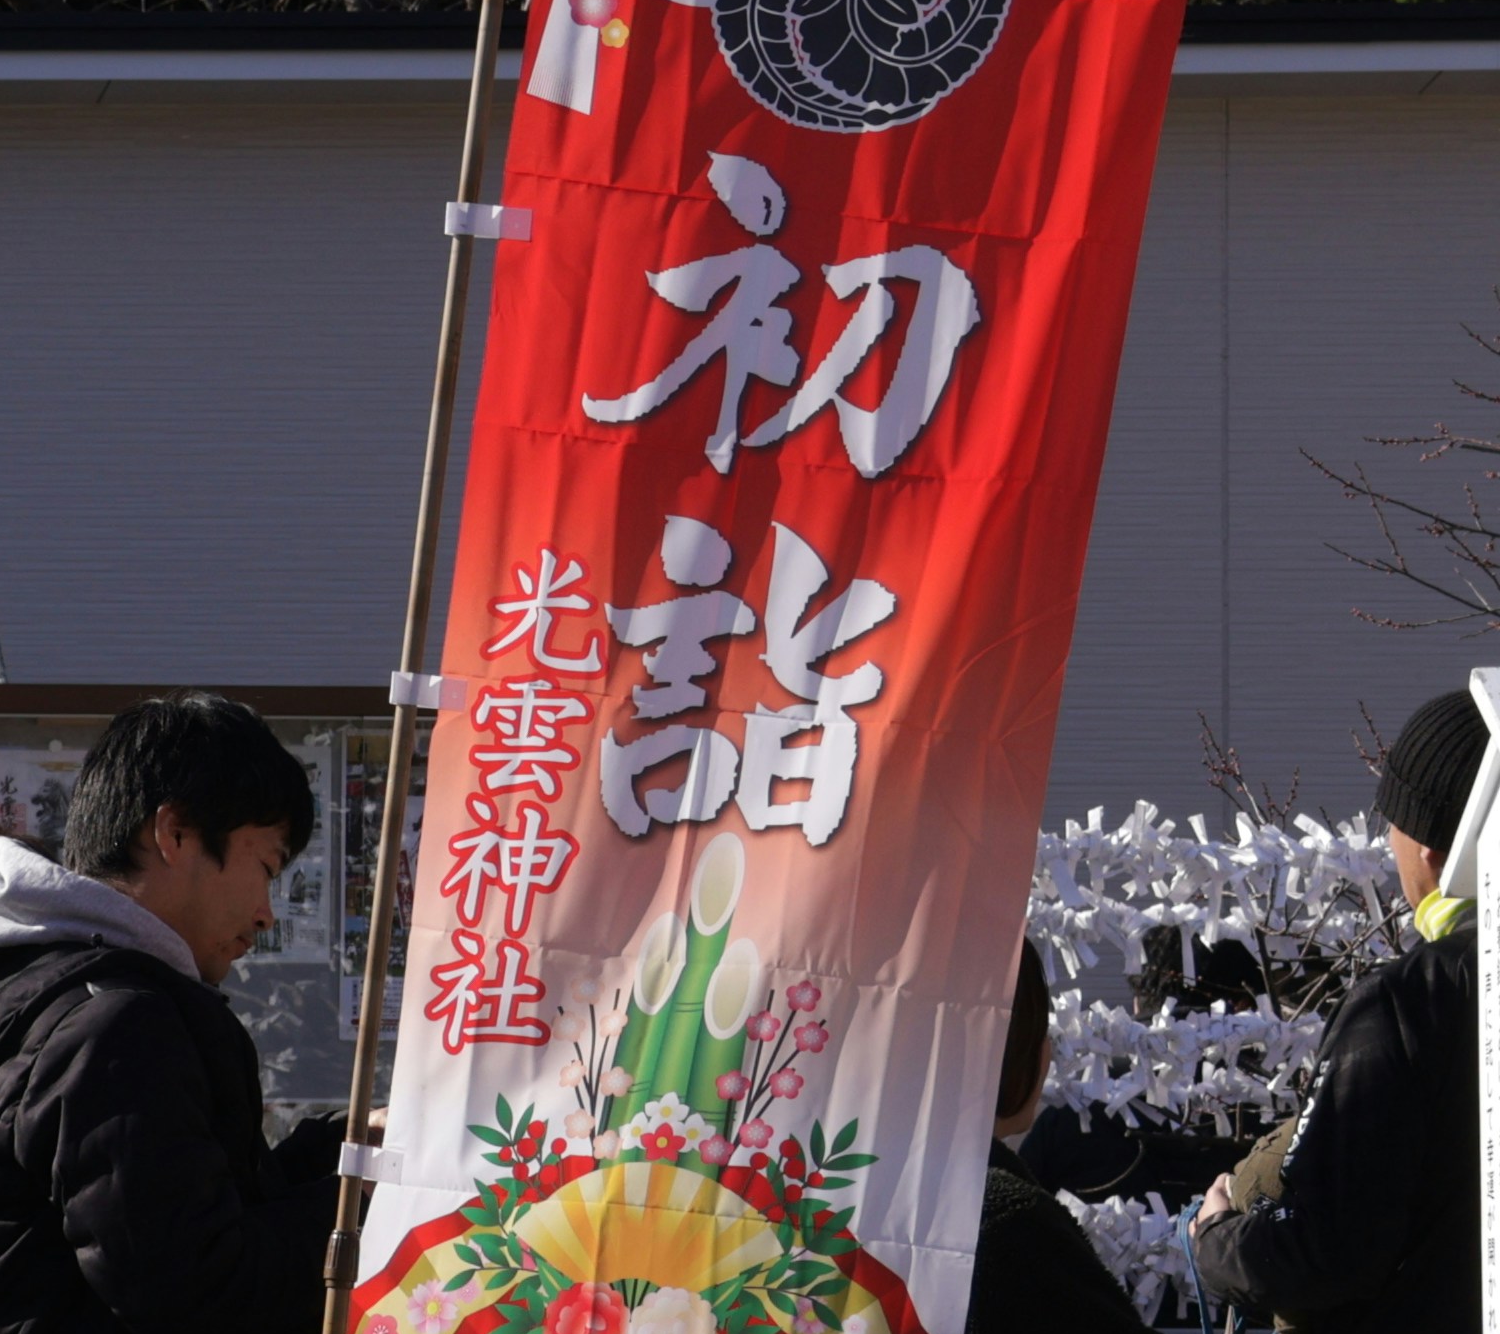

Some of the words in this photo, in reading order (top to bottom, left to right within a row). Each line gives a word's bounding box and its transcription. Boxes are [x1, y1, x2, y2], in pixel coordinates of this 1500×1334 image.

[582, 150, 981, 845] 初詣
[428, 545, 604, 1051] 光雲神社
